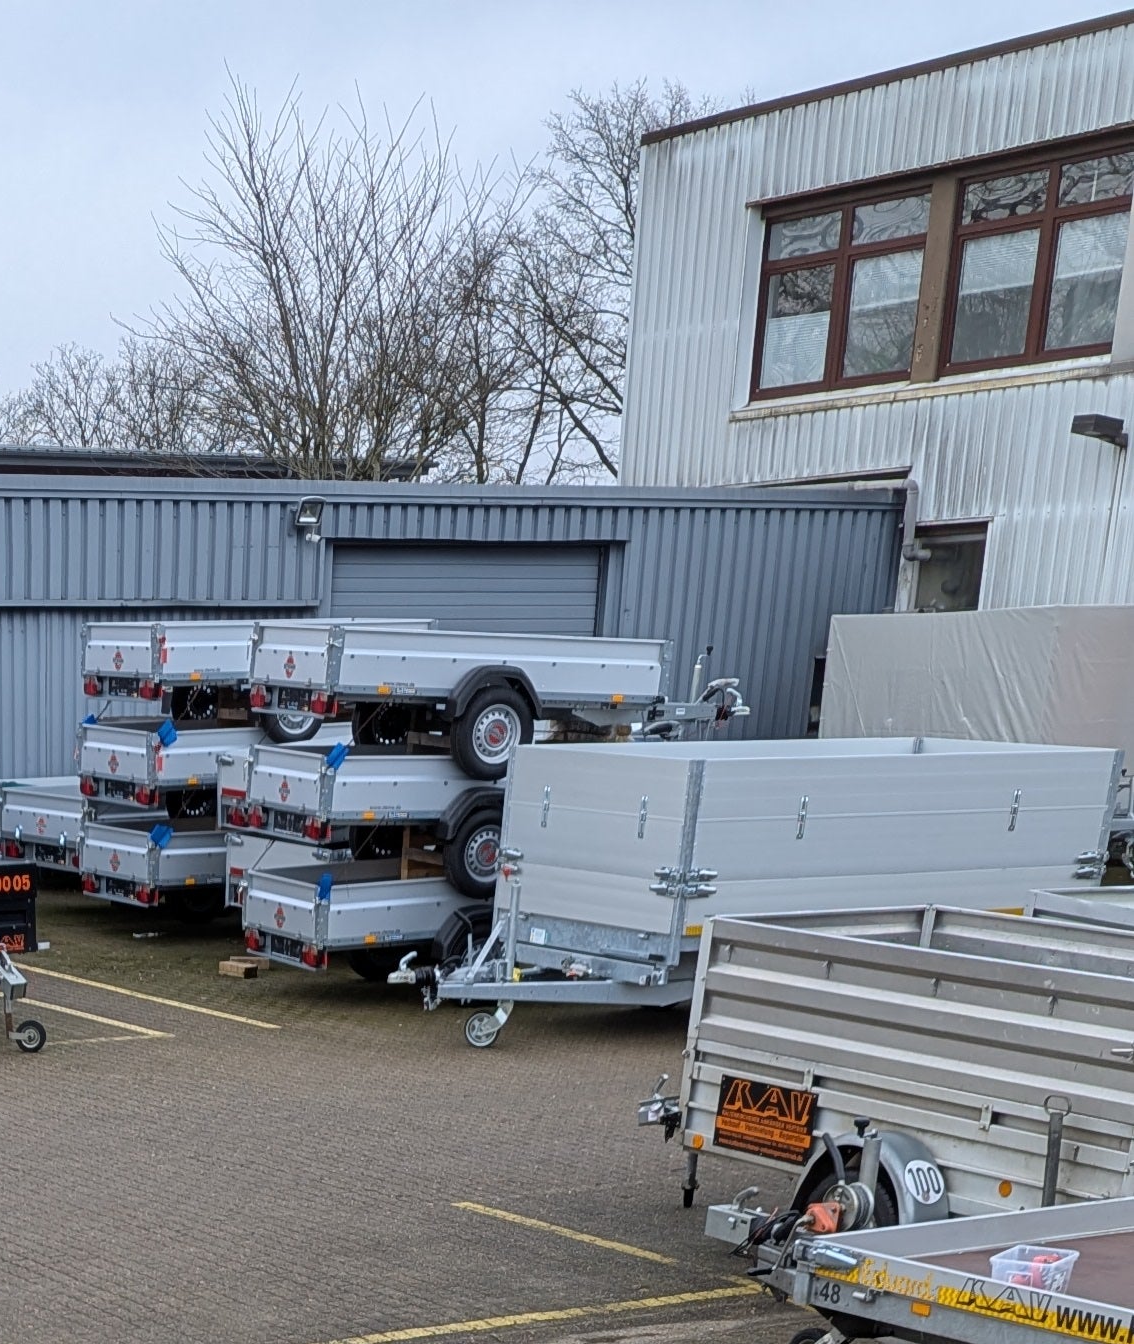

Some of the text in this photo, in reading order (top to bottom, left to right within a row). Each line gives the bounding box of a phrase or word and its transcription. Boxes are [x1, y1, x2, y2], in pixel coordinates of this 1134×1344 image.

[723, 1079, 812, 1126] KAV
[908, 1167, 941, 1197] 100
[820, 1281, 842, 1304] 48
[860, 1257, 937, 1301] Eduard
[957, 1278, 1053, 1323] KAV
